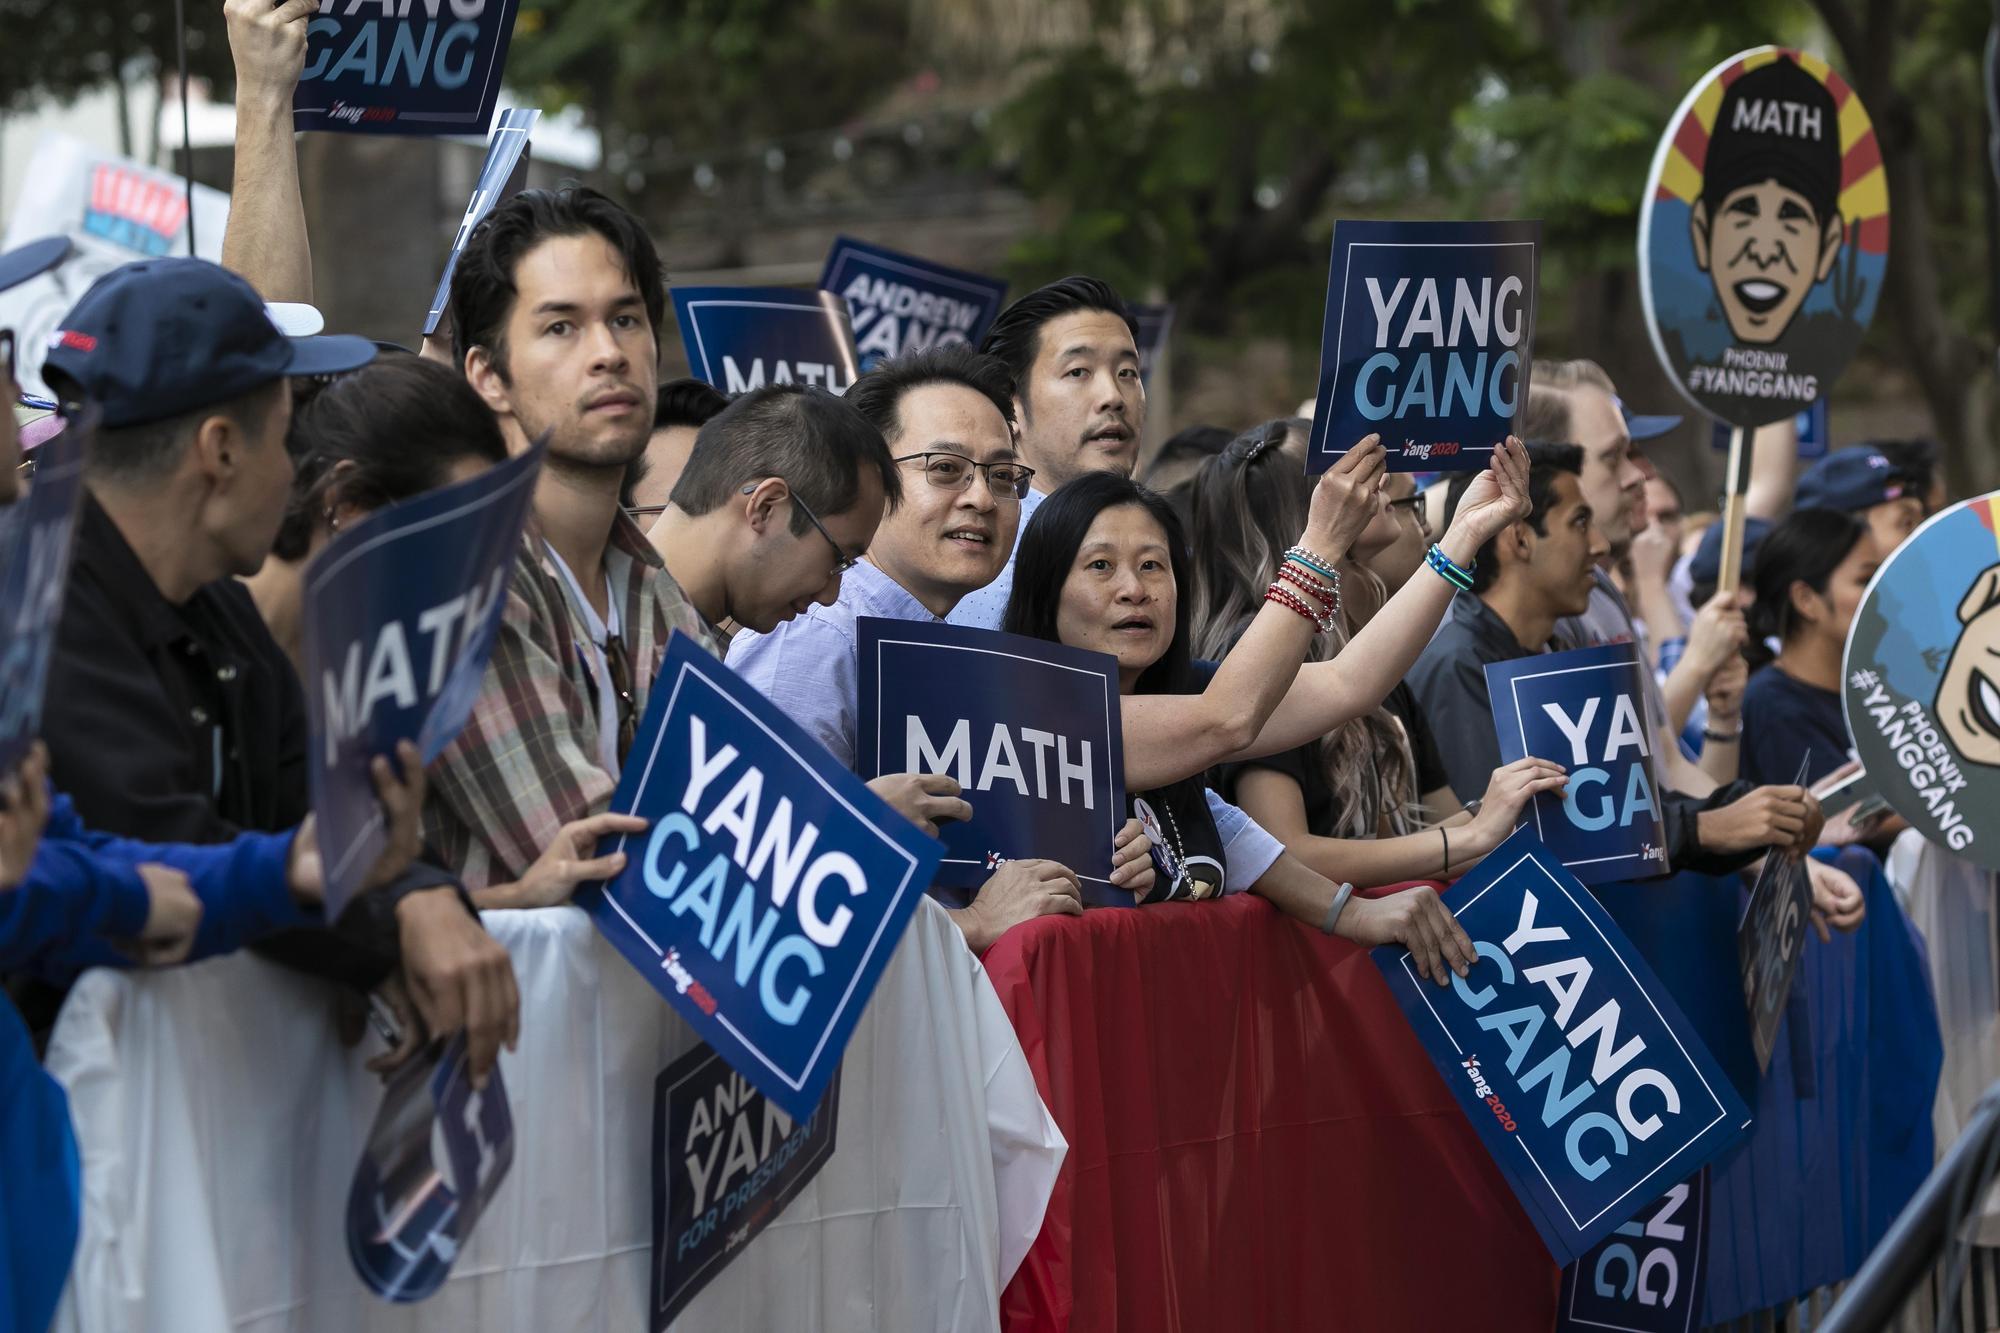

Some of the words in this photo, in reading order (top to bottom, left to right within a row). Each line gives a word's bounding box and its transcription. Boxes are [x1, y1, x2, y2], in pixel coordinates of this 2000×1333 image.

[298, 17, 480, 90] GANG
[1732, 97, 1821, 142] MATH
[843, 272, 981, 332] ANDREW
[1365, 275, 1523, 348] YANG
[1354, 350, 1520, 421] GANG
[1688, 364, 1818, 402] #YANGGANG
[1723, 347, 1789, 371] PHOENIX
[1403, 438, 1459, 460] Yang2020
[906, 714, 1095, 810] MATH
[1541, 693, 1650, 766] YA
[1850, 668, 1974, 850] #YANGGANG
[1901, 699, 1967, 794] PHOENIX
[681, 714, 868, 948] YANG
[1562, 762, 1661, 832] GA
[643, 811, 825, 1026] GANG
[1502, 888, 1681, 1142] YANG
[1451, 940, 1629, 1182] GANG
[1461, 1054, 1517, 1132] Yang2020
[677, 1207, 719, 1263] FOR
